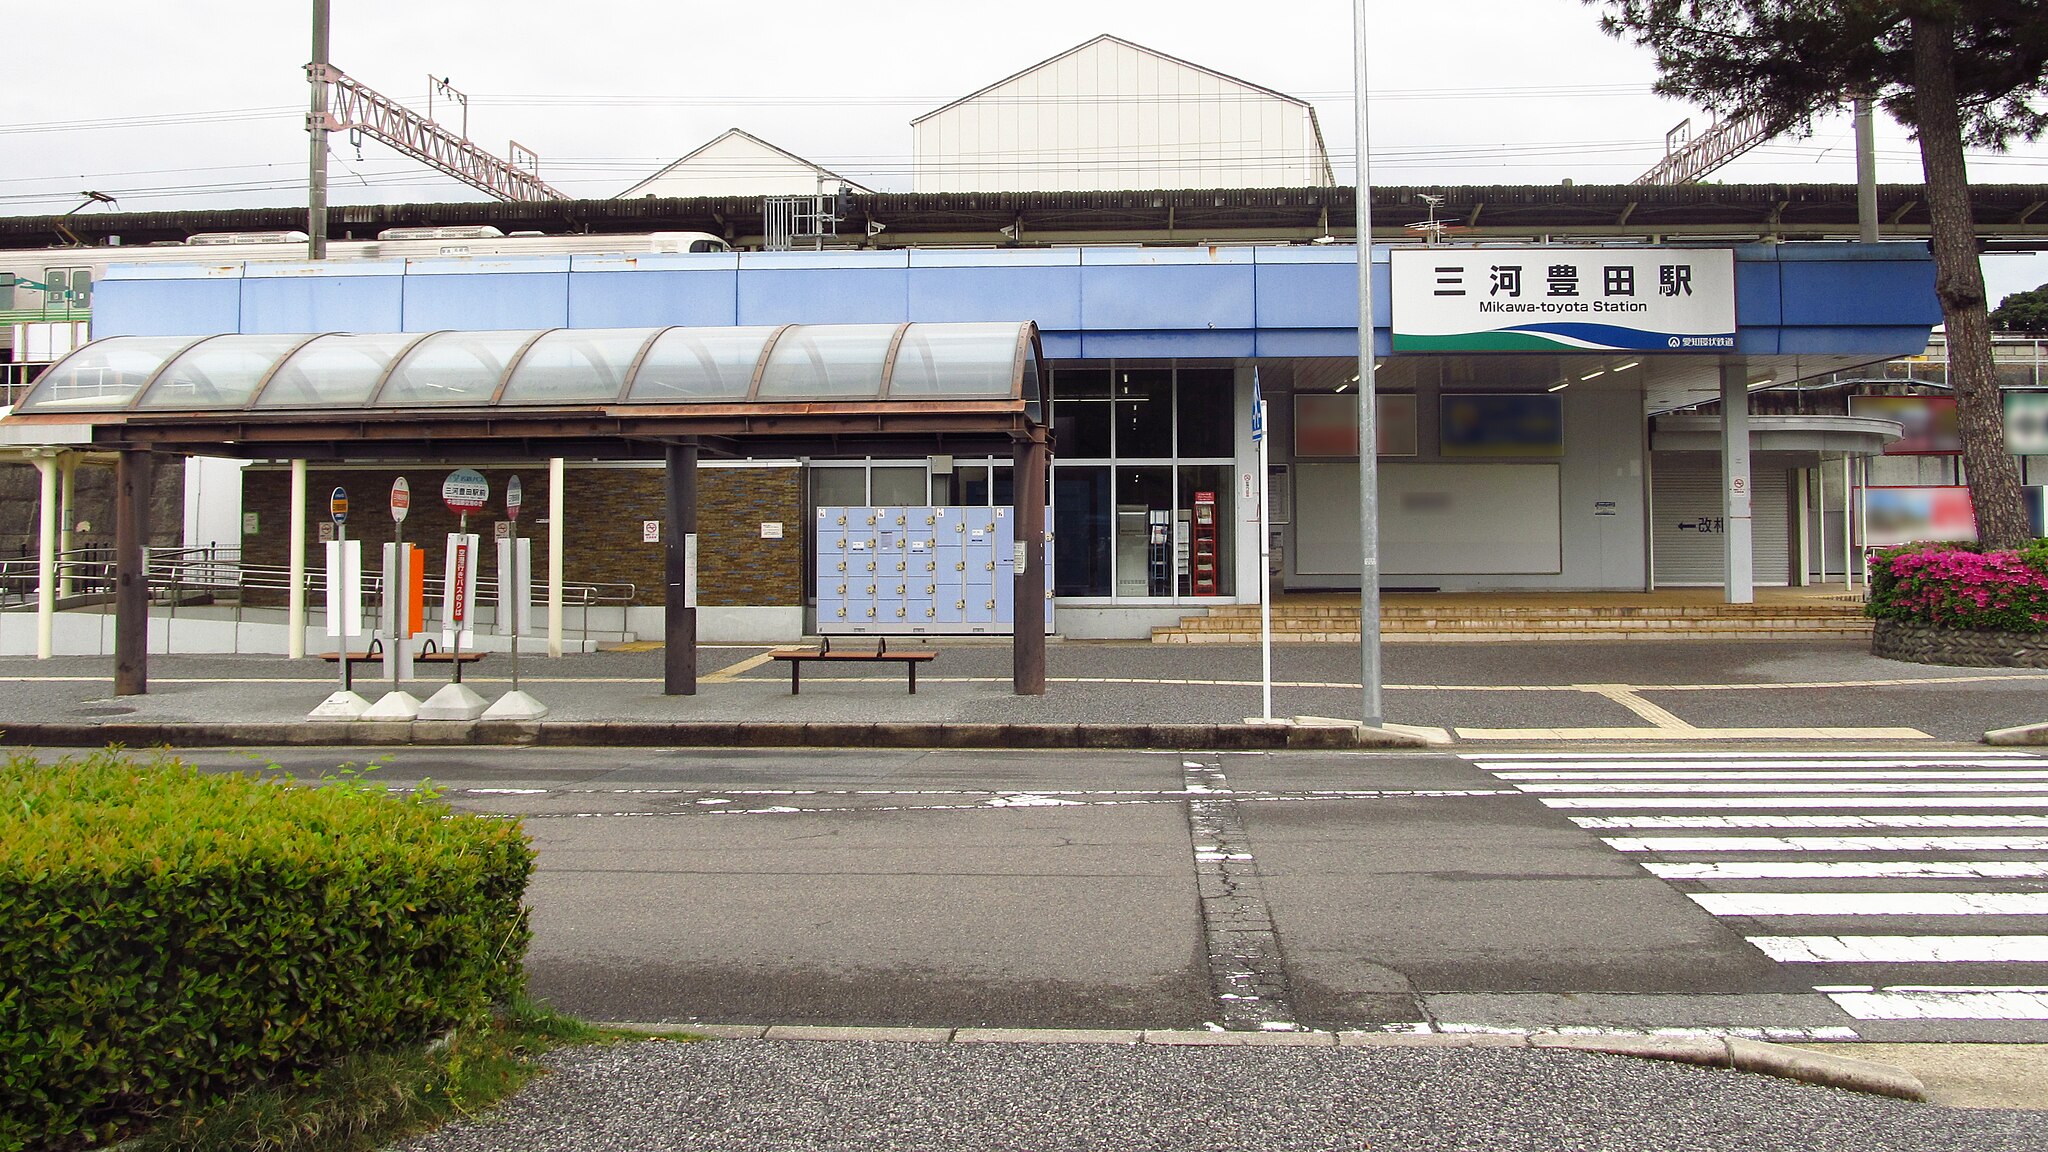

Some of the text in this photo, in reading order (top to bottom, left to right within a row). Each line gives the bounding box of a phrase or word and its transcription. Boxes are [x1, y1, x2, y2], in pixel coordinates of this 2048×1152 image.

[1433, 264, 1693, 297] 三河豊田駅
[1479, 300, 1648, 314] Mikawa-toyota Station
[1682, 337, 1734, 347] 愛知環状鉄道
[445, 487, 486, 497] 三河豊田駅前
[454, 549, 466, 617] 空港行きバスのりば
